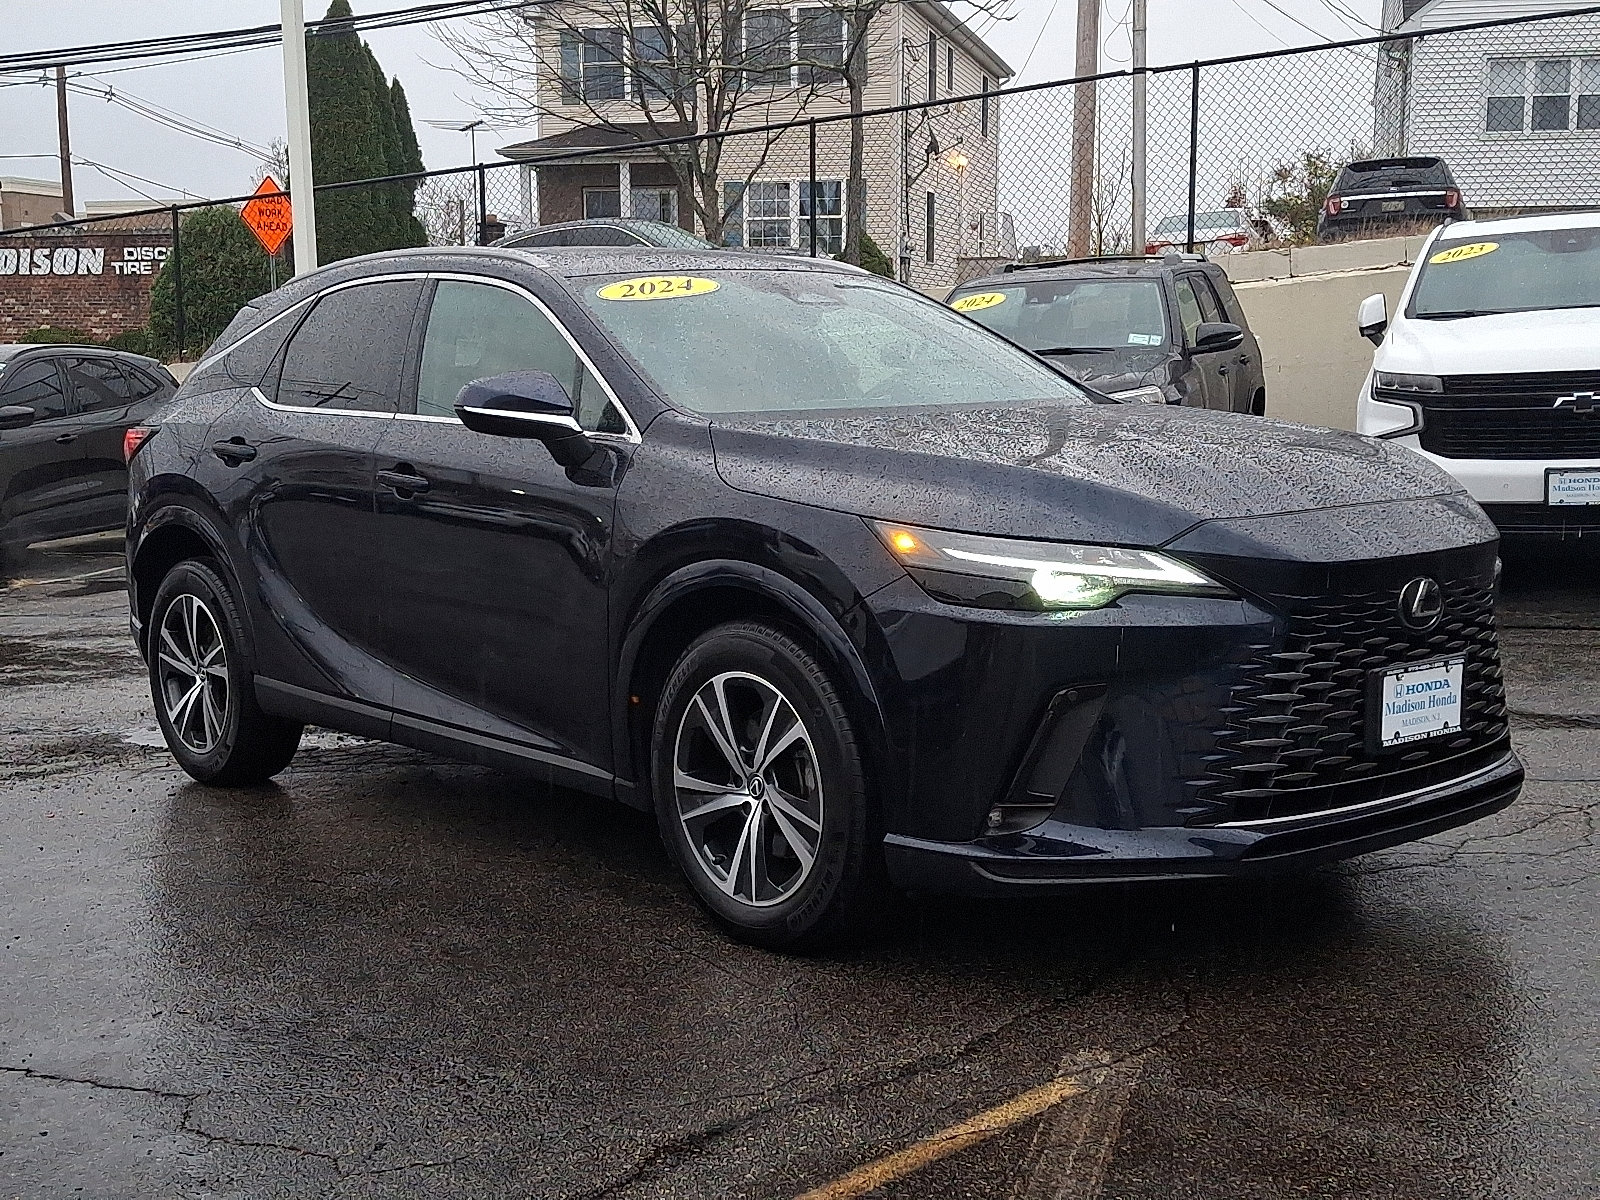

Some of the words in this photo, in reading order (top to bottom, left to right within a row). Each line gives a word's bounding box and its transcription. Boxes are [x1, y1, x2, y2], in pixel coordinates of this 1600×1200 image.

[258, 207, 282, 218] WORK
[257, 221, 288, 232] AHEAD
[124, 246, 173, 261] DISC
[1440, 245, 1486, 261] 2023
[111, 261, 153, 275] TIRE
[619, 279, 693, 298] 2024
[957, 295, 996, 310] 2024
[1406, 679, 1451, 695] HONDA
[1385, 699, 1425, 716] Madison
[1428, 692, 1457, 708] Honda
[1383, 733, 1428, 746] MADISON
[1429, 726, 1462, 737] HONDA
